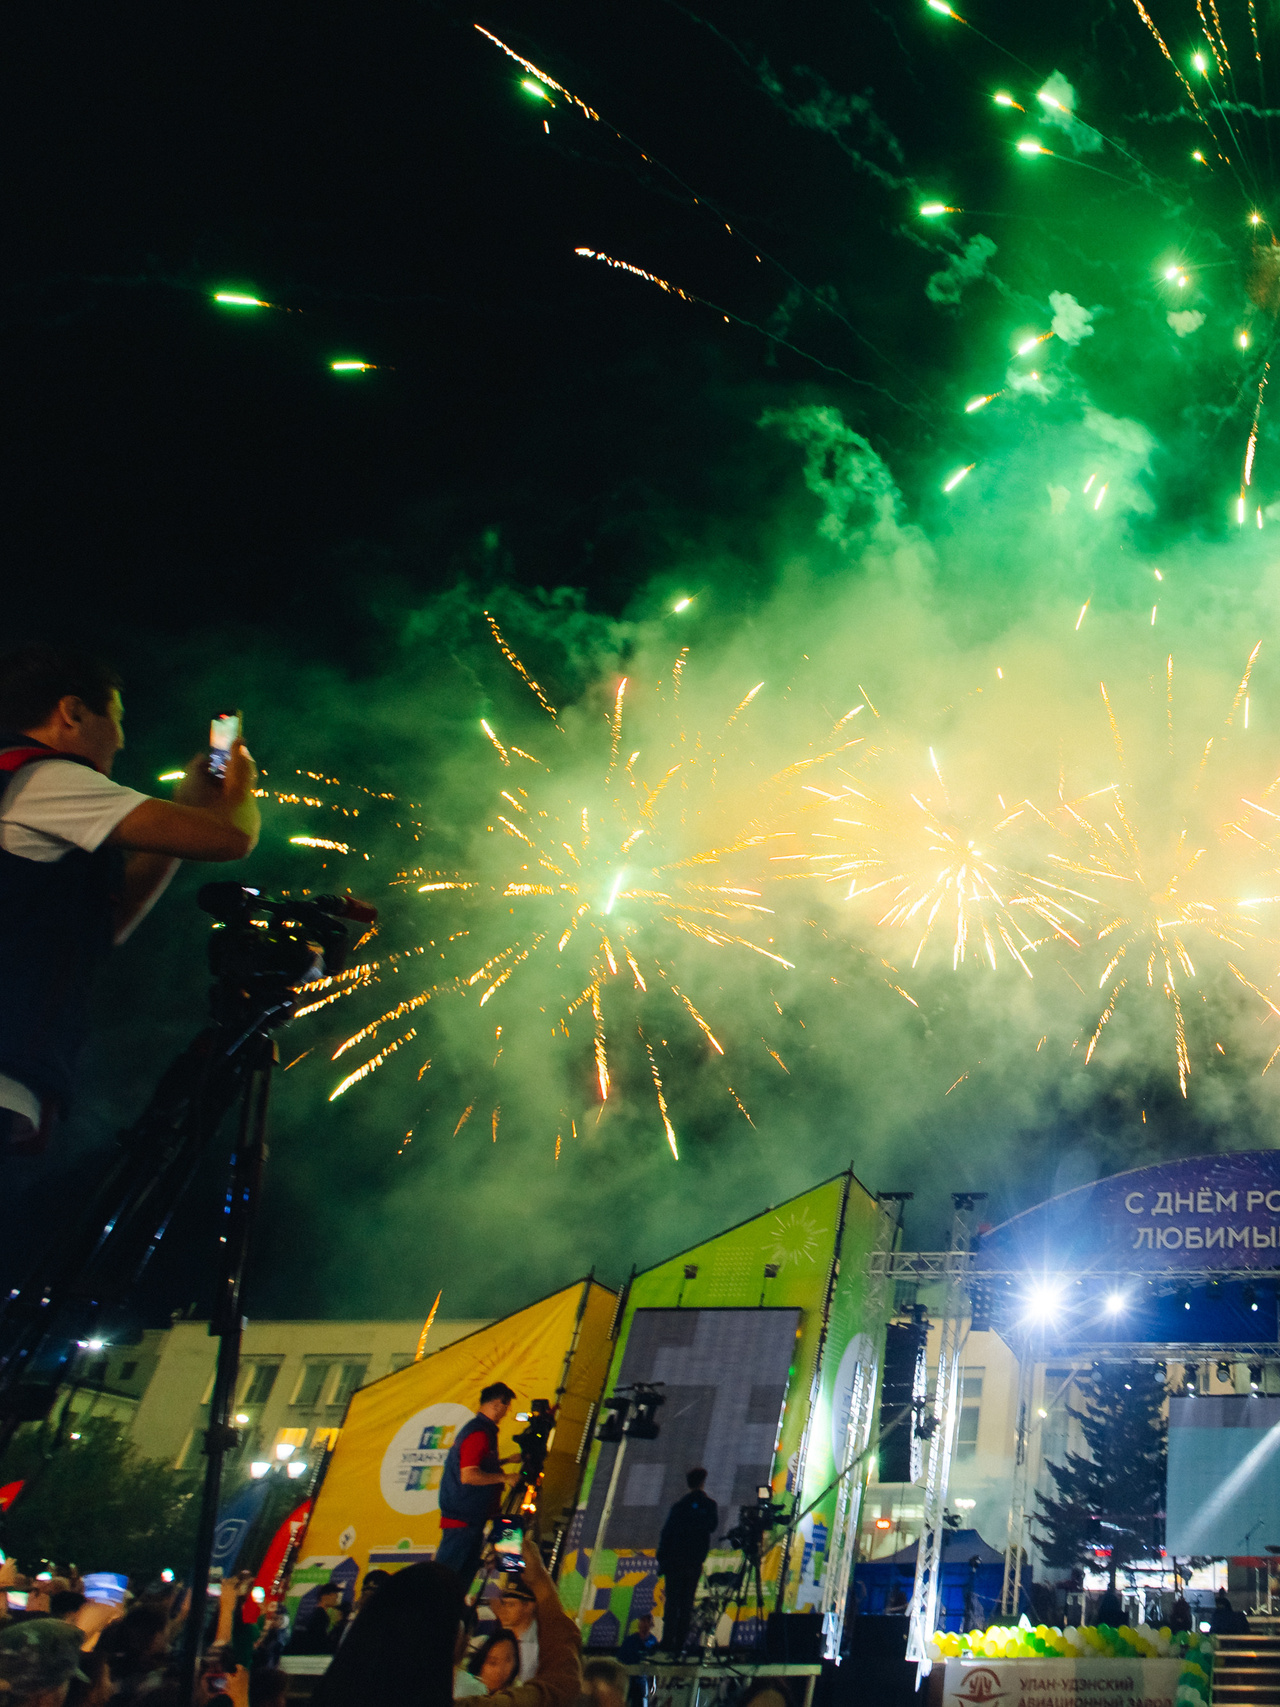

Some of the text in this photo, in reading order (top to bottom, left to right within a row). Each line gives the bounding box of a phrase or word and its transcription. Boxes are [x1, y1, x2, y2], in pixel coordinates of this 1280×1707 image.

[1125, 1192, 1144, 1214] С
[1151, 1187, 1238, 1215] ДНЁМ
[1019, 1676, 1135, 1692] УЛАН-УДЭНСКИЙ
